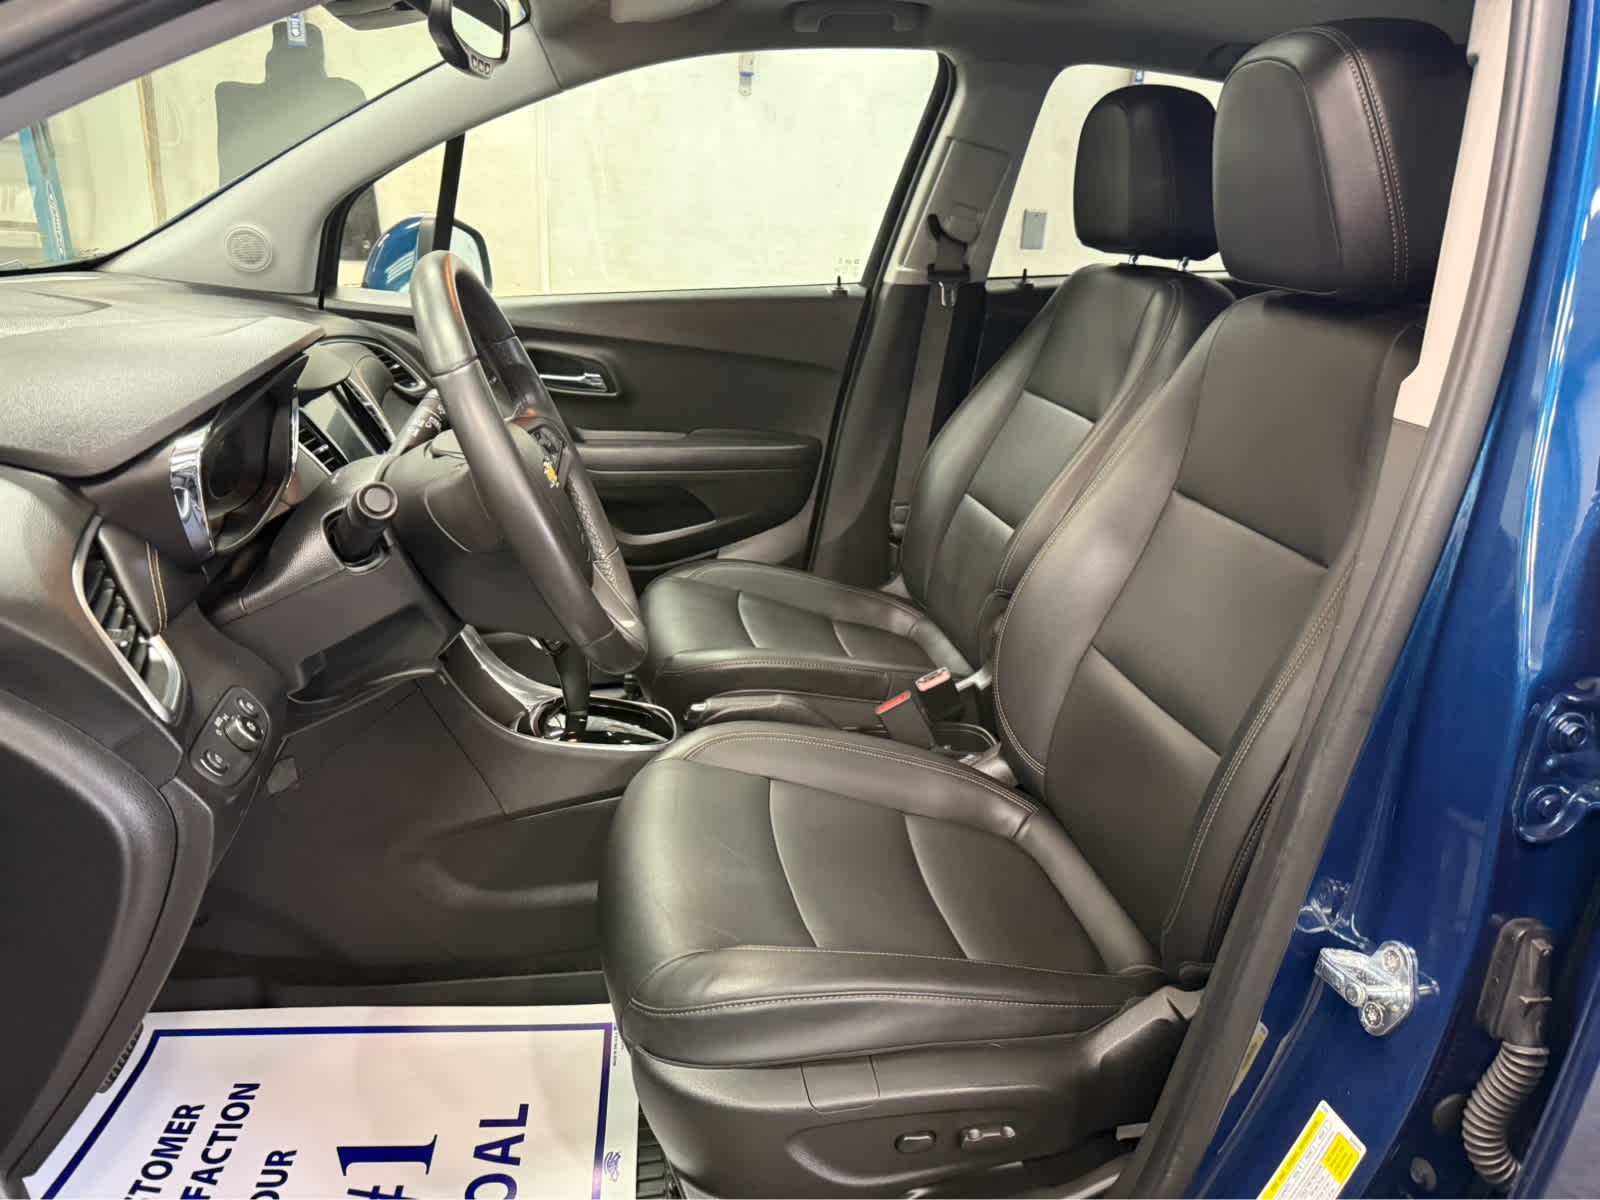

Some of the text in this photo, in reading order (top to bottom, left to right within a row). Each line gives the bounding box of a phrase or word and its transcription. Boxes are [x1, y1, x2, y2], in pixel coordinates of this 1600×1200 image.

[124, 1104, 205, 1199] TOMER
[180, 1083, 261, 1199] FACTION
[464, 1103, 529, 1199] OAL
